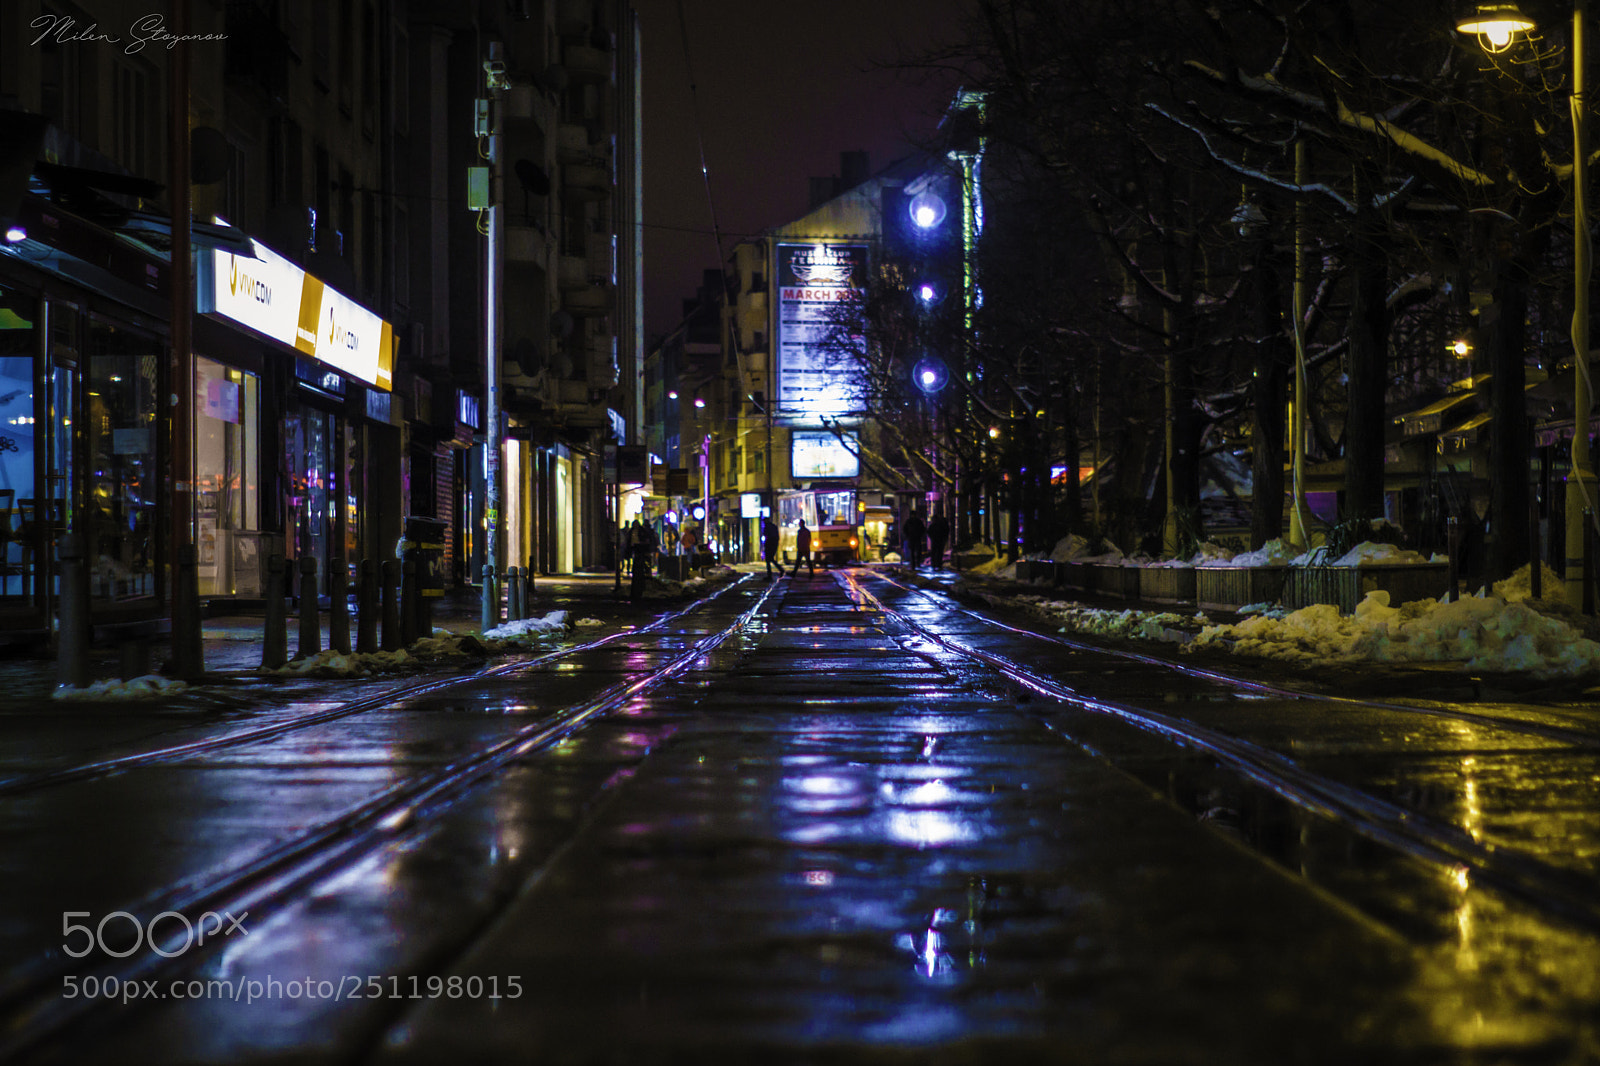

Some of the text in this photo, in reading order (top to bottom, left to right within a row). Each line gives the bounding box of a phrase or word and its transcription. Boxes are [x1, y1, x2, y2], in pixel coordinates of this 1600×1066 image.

[790, 256, 850, 265] TERNA
[239, 270, 272, 306] VIVACOM
[783, 289, 859, 301] MARCH 20
